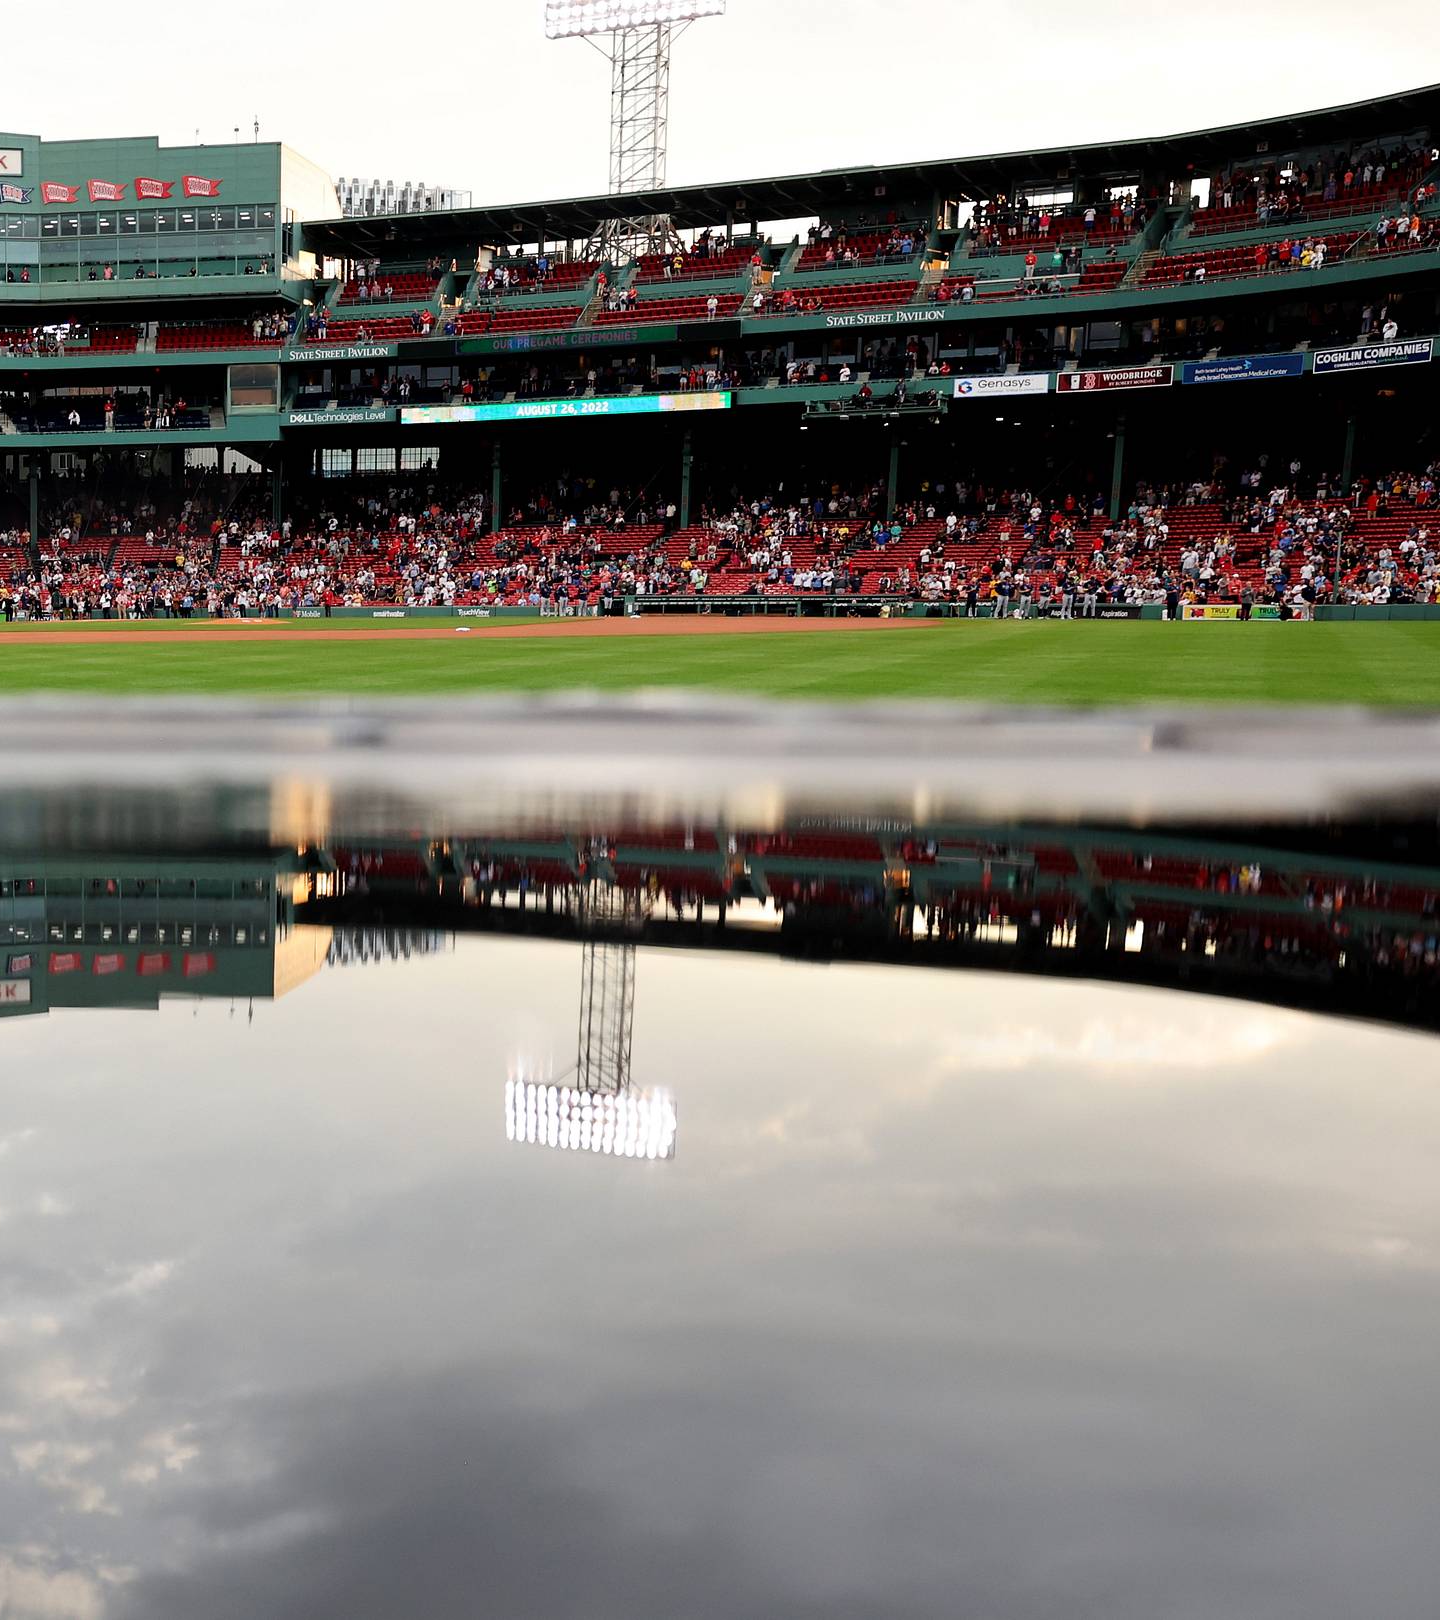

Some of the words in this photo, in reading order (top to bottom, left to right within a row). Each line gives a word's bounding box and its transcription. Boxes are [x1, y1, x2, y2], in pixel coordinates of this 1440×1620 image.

[826, 316, 856, 326] STATE
[896, 310, 945, 322] PAVILION
[493, 340, 512, 349] OUR
[517, 335, 567, 348] PREGAME
[571, 331, 638, 344] CEREMONIES
[289, 351, 314, 360] STATE
[348, 347, 388, 357] PAVILION
[1317, 350, 1362, 364] COGHLIN
[1364, 342, 1431, 359] COMPANIES
[1103, 370, 1163, 382] WOODBRIDGE
[1248, 369, 1269, 377] Medical
[978, 379, 1032, 389] Genasys
[516, 404, 558, 416] AUGUST
[560, 403, 578, 415] 26,
[581, 401, 609, 413] 2022
[290, 413, 313, 423] DELL
[313, 412, 364, 423] Technologies
[365, 411, 386, 420] Level
